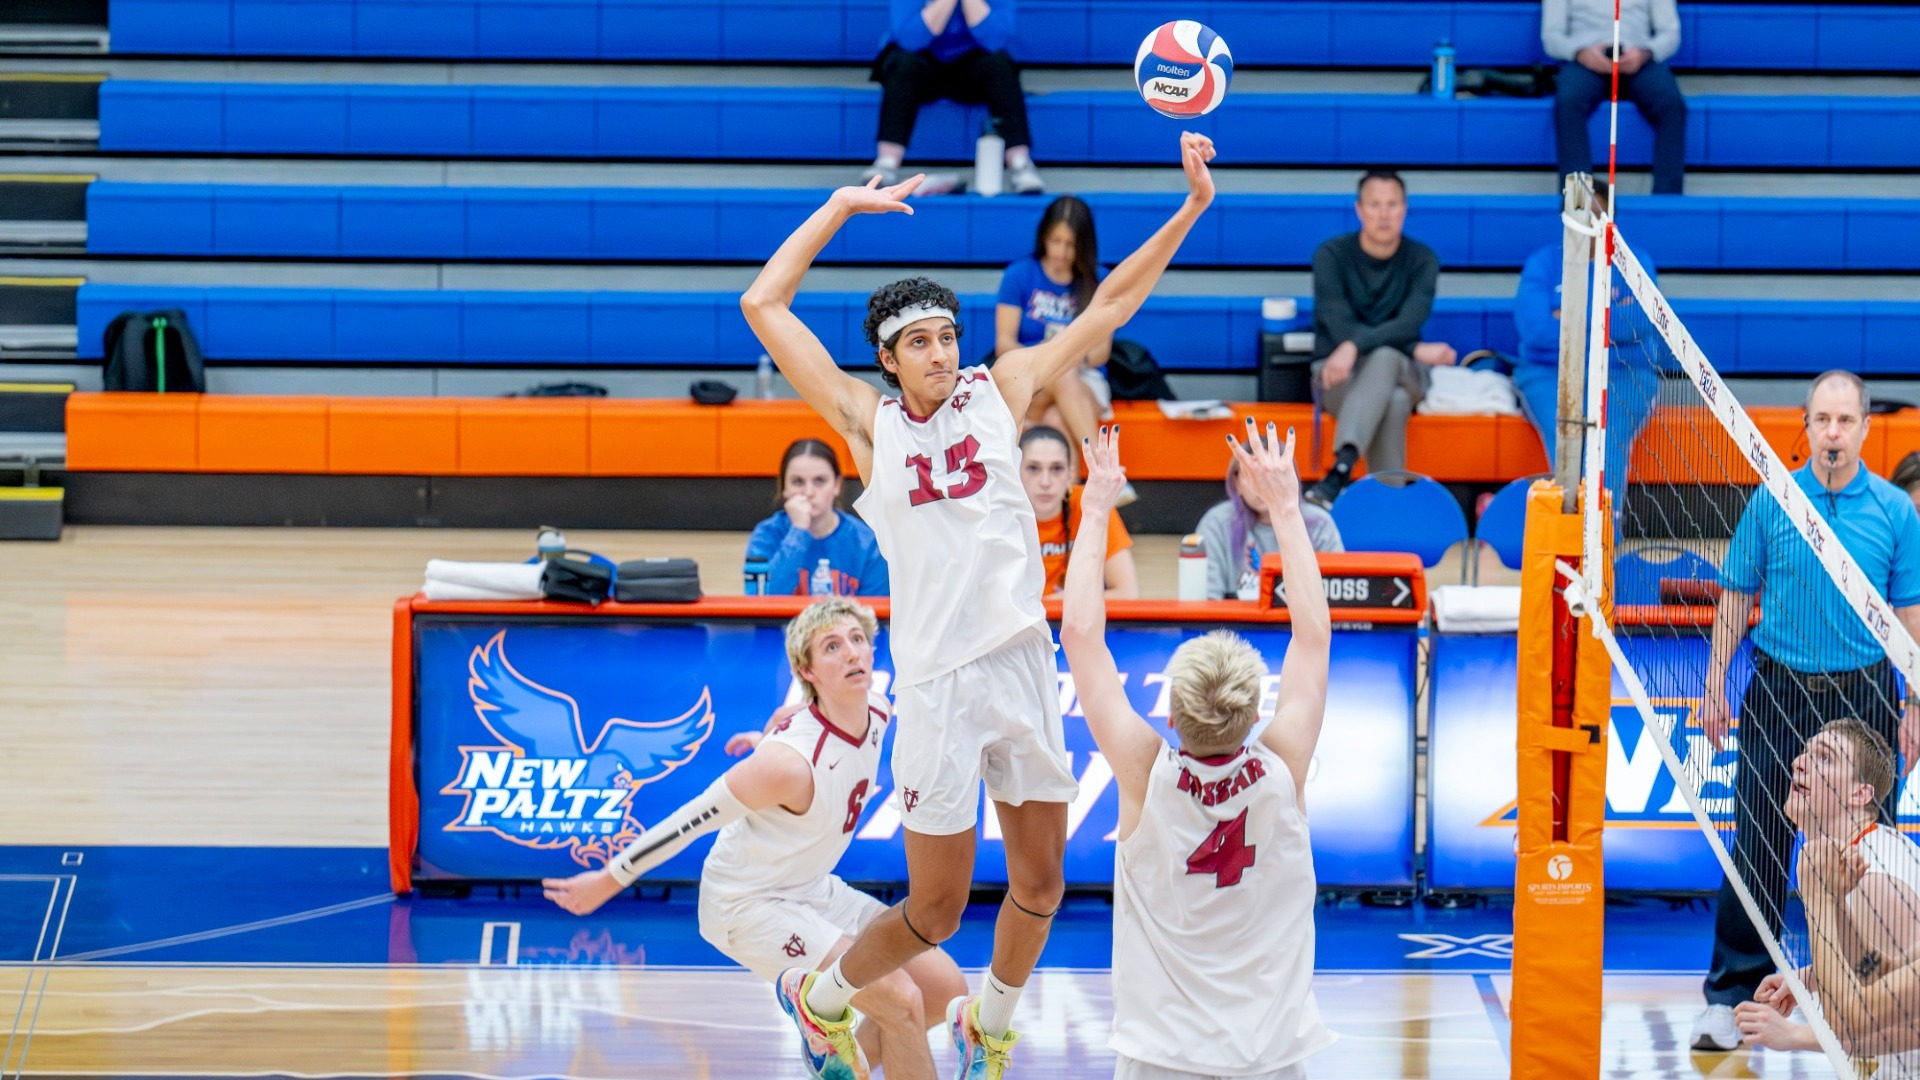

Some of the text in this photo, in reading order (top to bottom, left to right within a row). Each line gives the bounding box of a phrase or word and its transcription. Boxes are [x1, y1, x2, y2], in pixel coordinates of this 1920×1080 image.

[1157, 63, 1190, 77] molten
[1153, 81, 1189, 98] NCAA
[905, 434, 988, 507] 13
[1323, 577, 1369, 601] OSS
[461, 751, 588, 789] NEW
[464, 788, 629, 826] PALTZ
[842, 778, 869, 834] 6
[519, 821, 614, 834] HAWKS
[1185, 805, 1257, 889] 4
